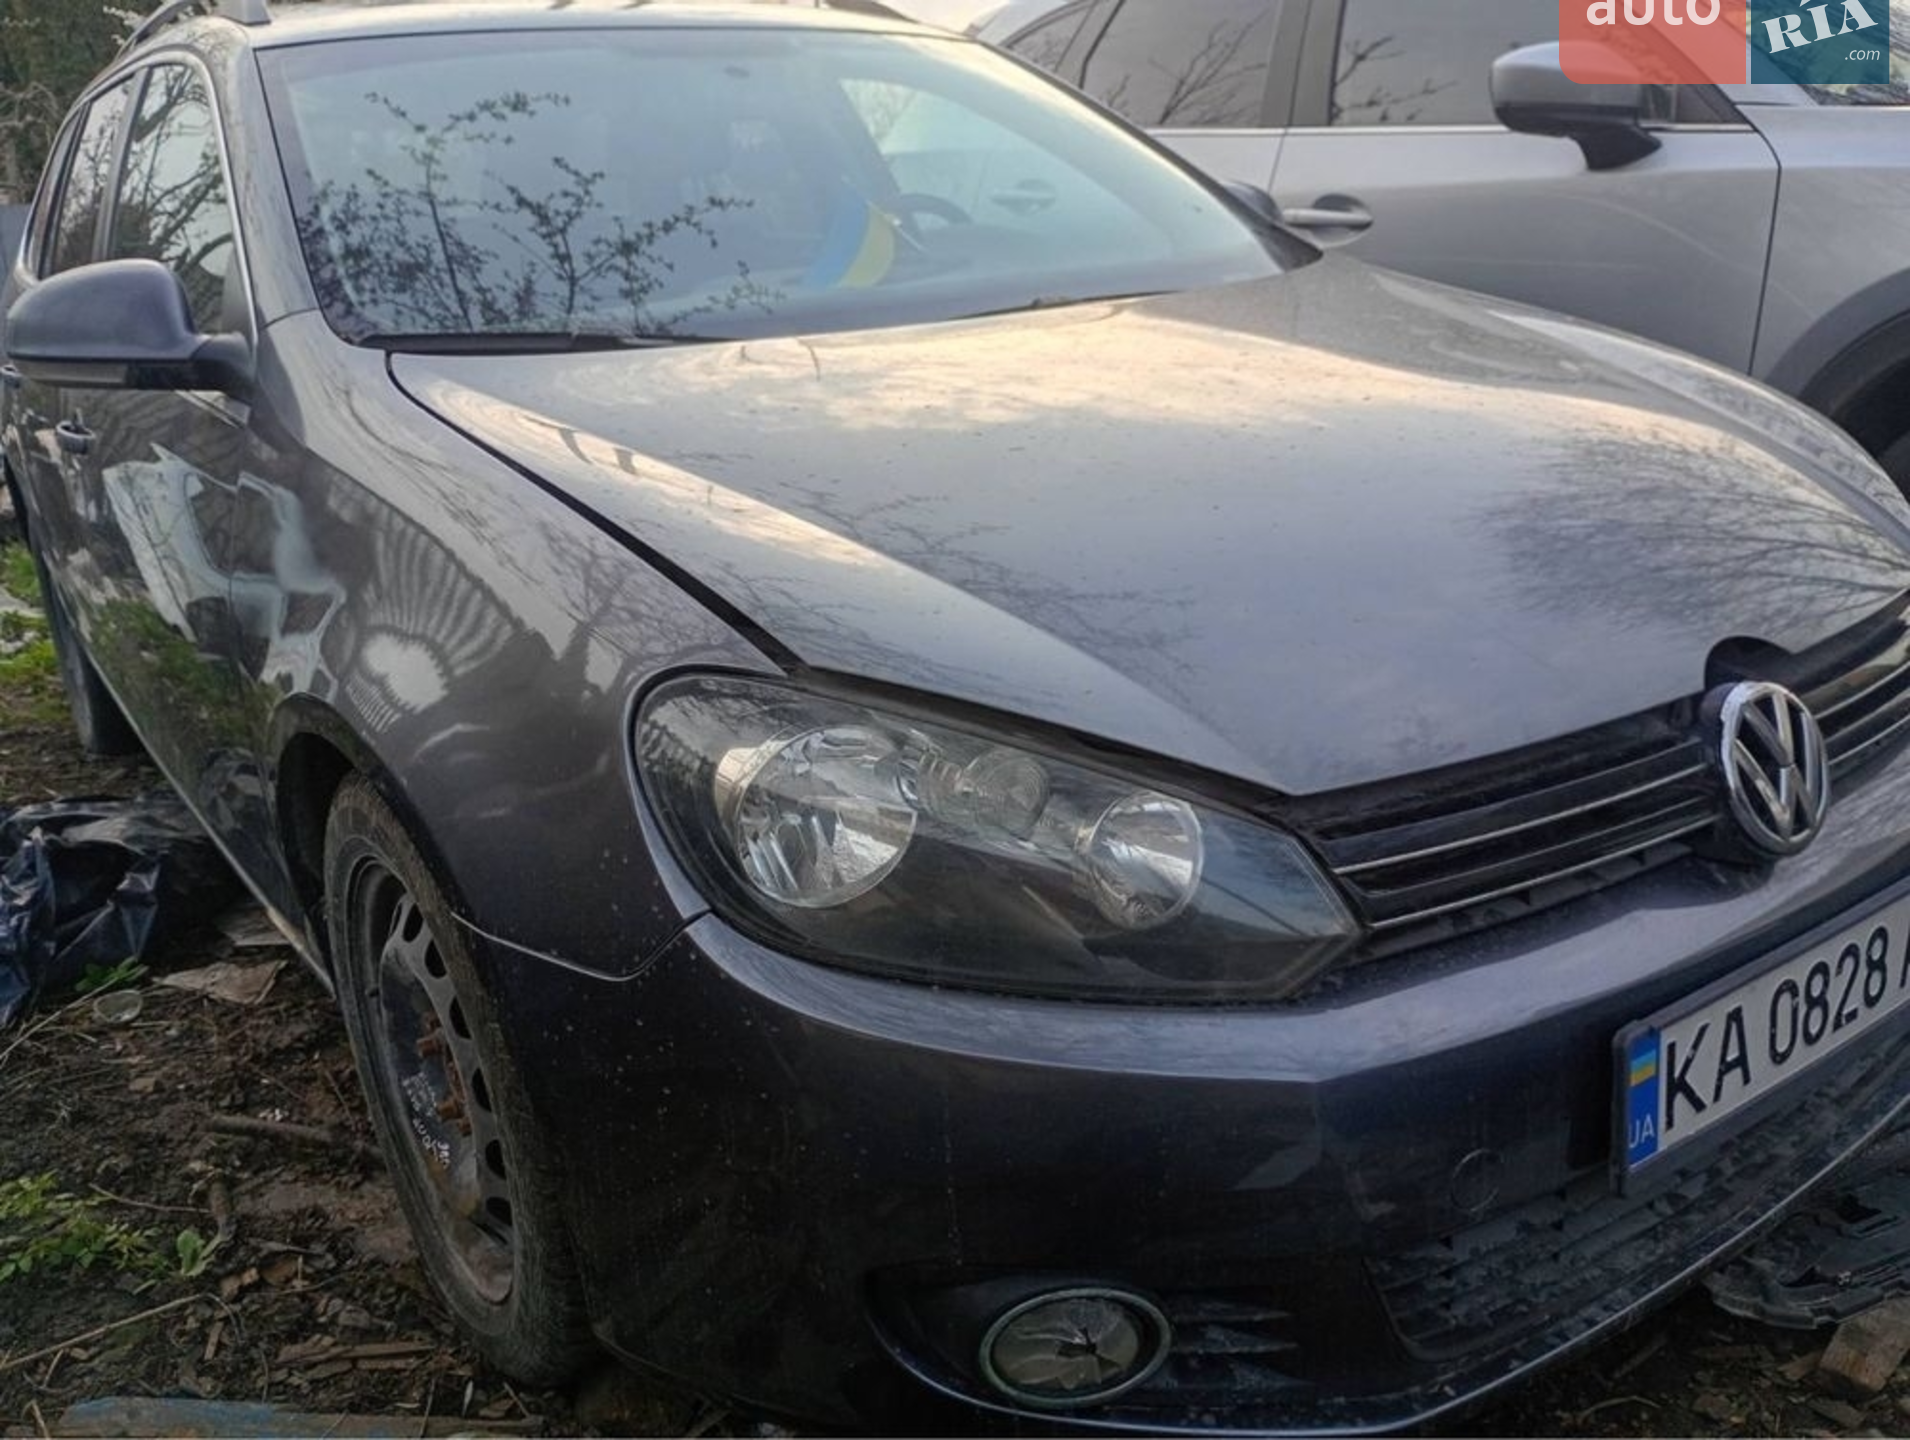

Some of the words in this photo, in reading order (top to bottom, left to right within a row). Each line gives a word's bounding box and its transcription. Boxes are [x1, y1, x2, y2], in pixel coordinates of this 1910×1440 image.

[1665, 1005, 1751, 1132] KA
[1768, 926, 1889, 1066] 0828
[1629, 1113, 1656, 1149] UA
